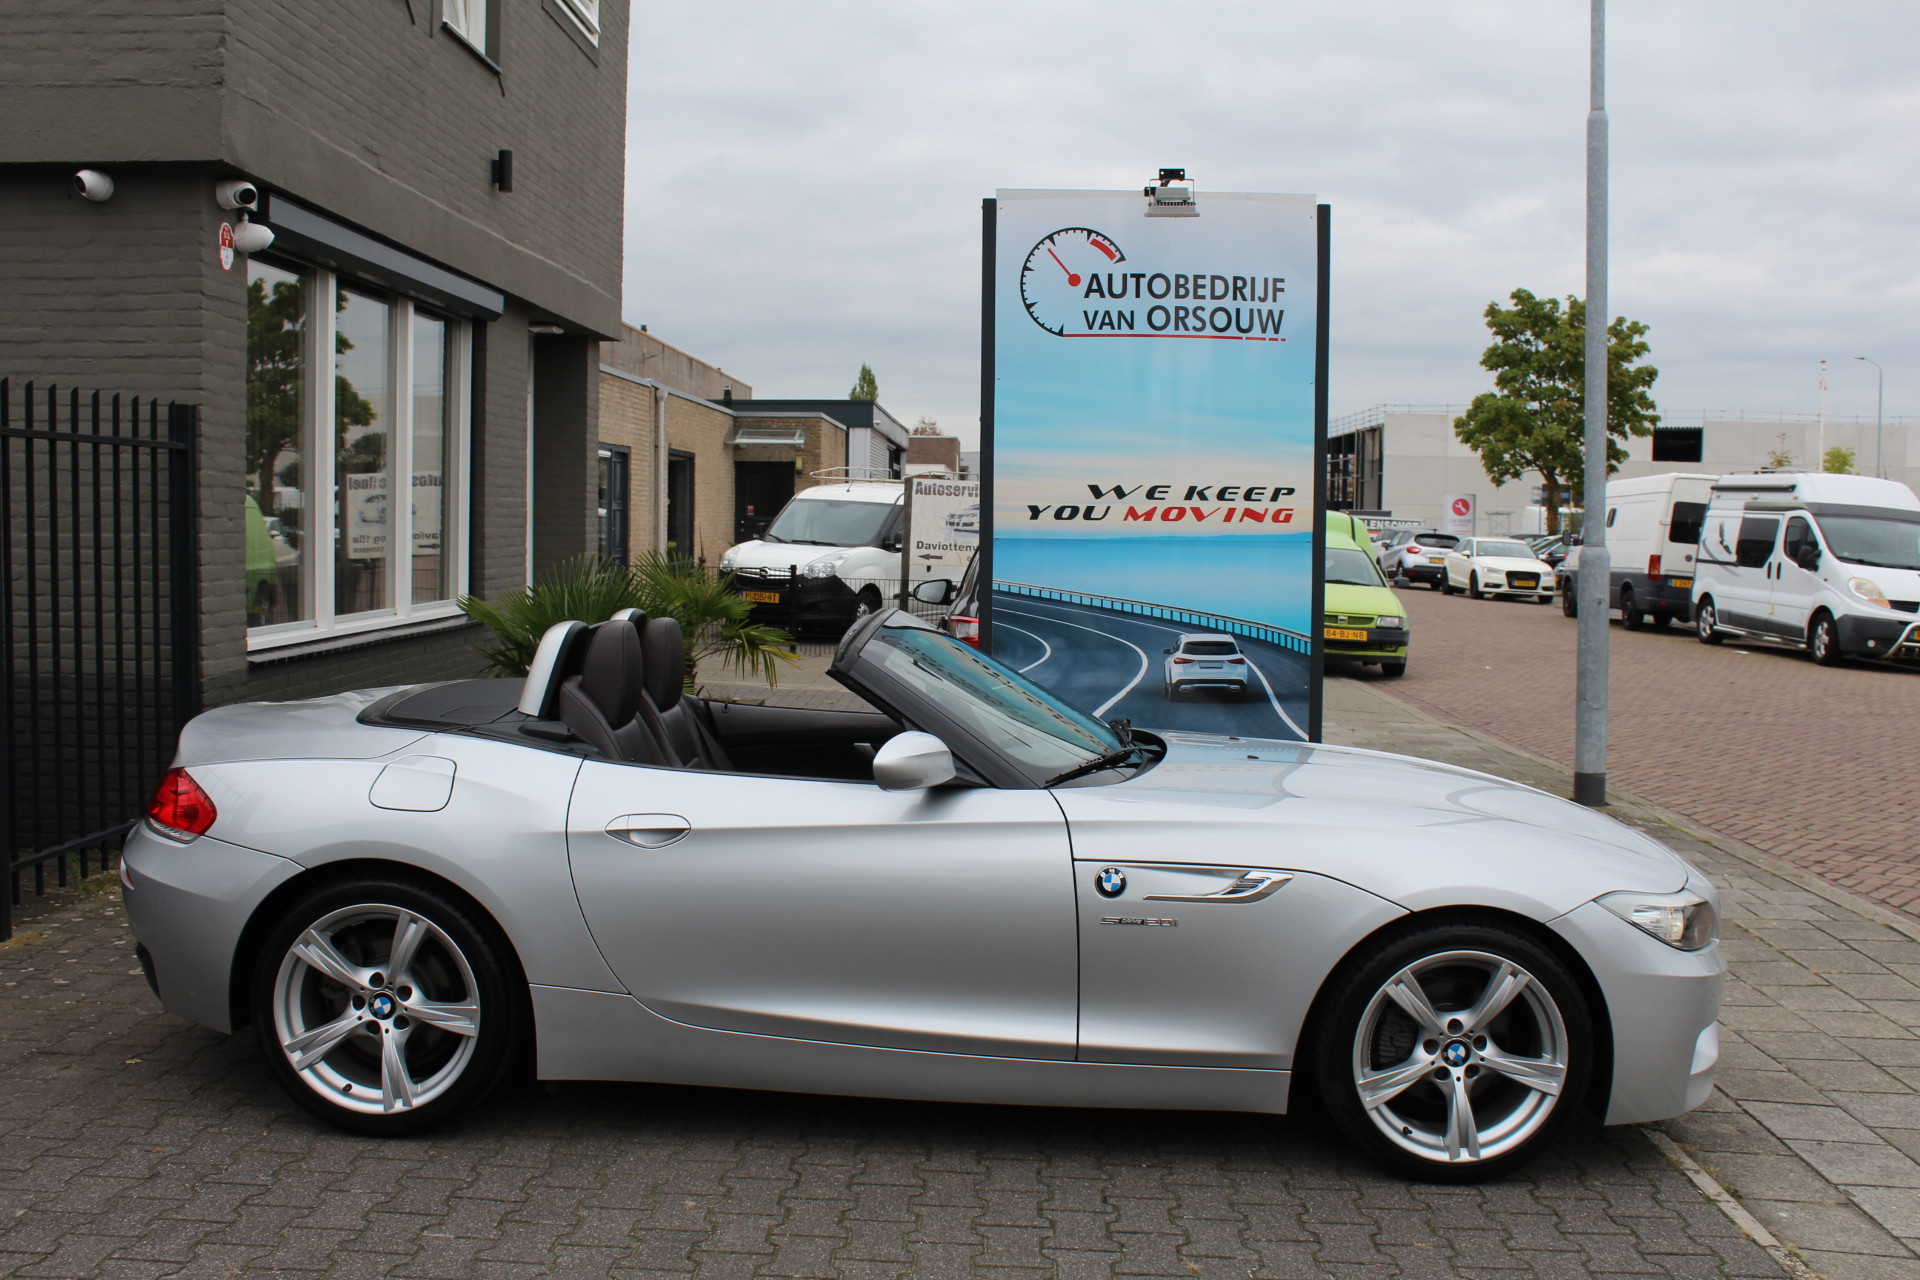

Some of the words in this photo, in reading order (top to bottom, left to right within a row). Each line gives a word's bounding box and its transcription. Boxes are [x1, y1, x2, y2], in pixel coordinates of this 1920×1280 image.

[1084, 273, 1285, 303] AUTOBEDRIJF
[1083, 309, 1135, 331] VAN
[1146, 304, 1285, 335] ORSOUW
[1087, 484, 1173, 501] WE
[1183, 485, 1296, 502] KEEP
[1027, 504, 1111, 521] YOU
[1123, 506, 1295, 523] MOVING
